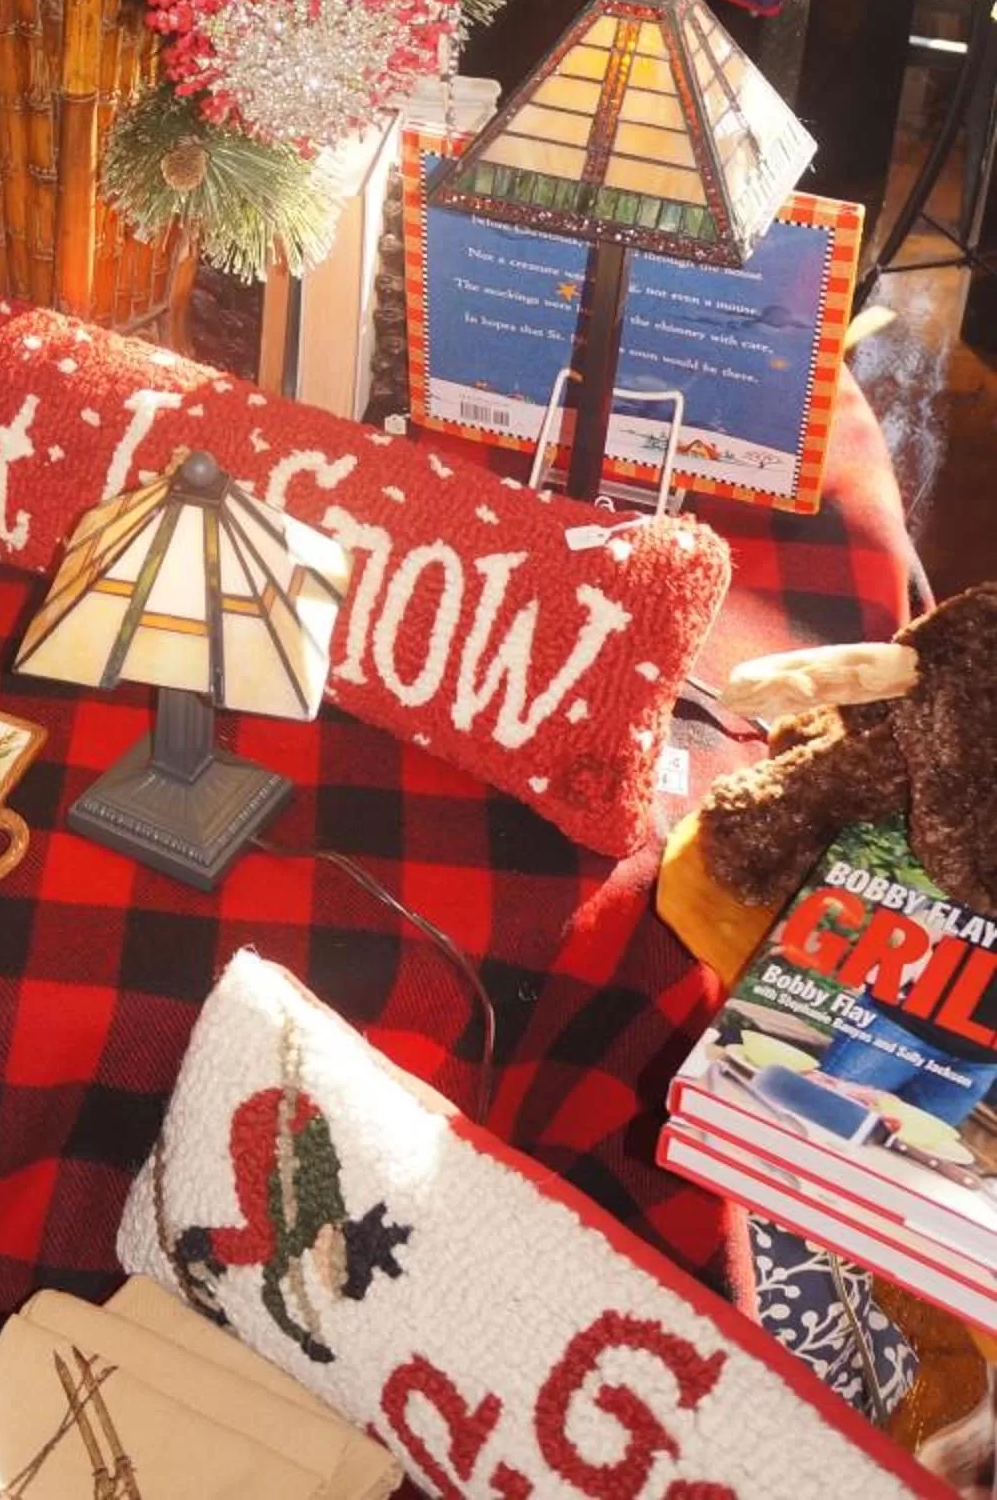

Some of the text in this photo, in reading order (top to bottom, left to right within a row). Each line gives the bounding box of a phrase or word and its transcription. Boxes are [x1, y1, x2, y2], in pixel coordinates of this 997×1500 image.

[467, 247, 495, 262] Not
[509, 259, 560, 276] creature
[453, 277, 480, 292] The
[544, 298, 572, 311] were
[645, 286, 668, 299] not
[671, 292, 700, 305] even
[481, 314, 516, 331] hopes
[519, 323, 543, 338] that
[630, 315, 651, 327] the
[654, 319, 706, 341] chimney
[709, 332, 738, 348] with
[662, 352, 699, 371] would
[702, 361, 718, 375] be
[824, 860, 997, 949] BOBBY FLAY
[780, 886, 997, 1051] GRIL
[761, 963, 878, 1029] Bobby Flay
[752, 984, 778, 1001] with
[777, 993, 833, 1025] Stephanie
[872, 1038, 898, 1053] and
[896, 1044, 925, 1067] Sally
[924, 1059, 974, 1088] Jackson
